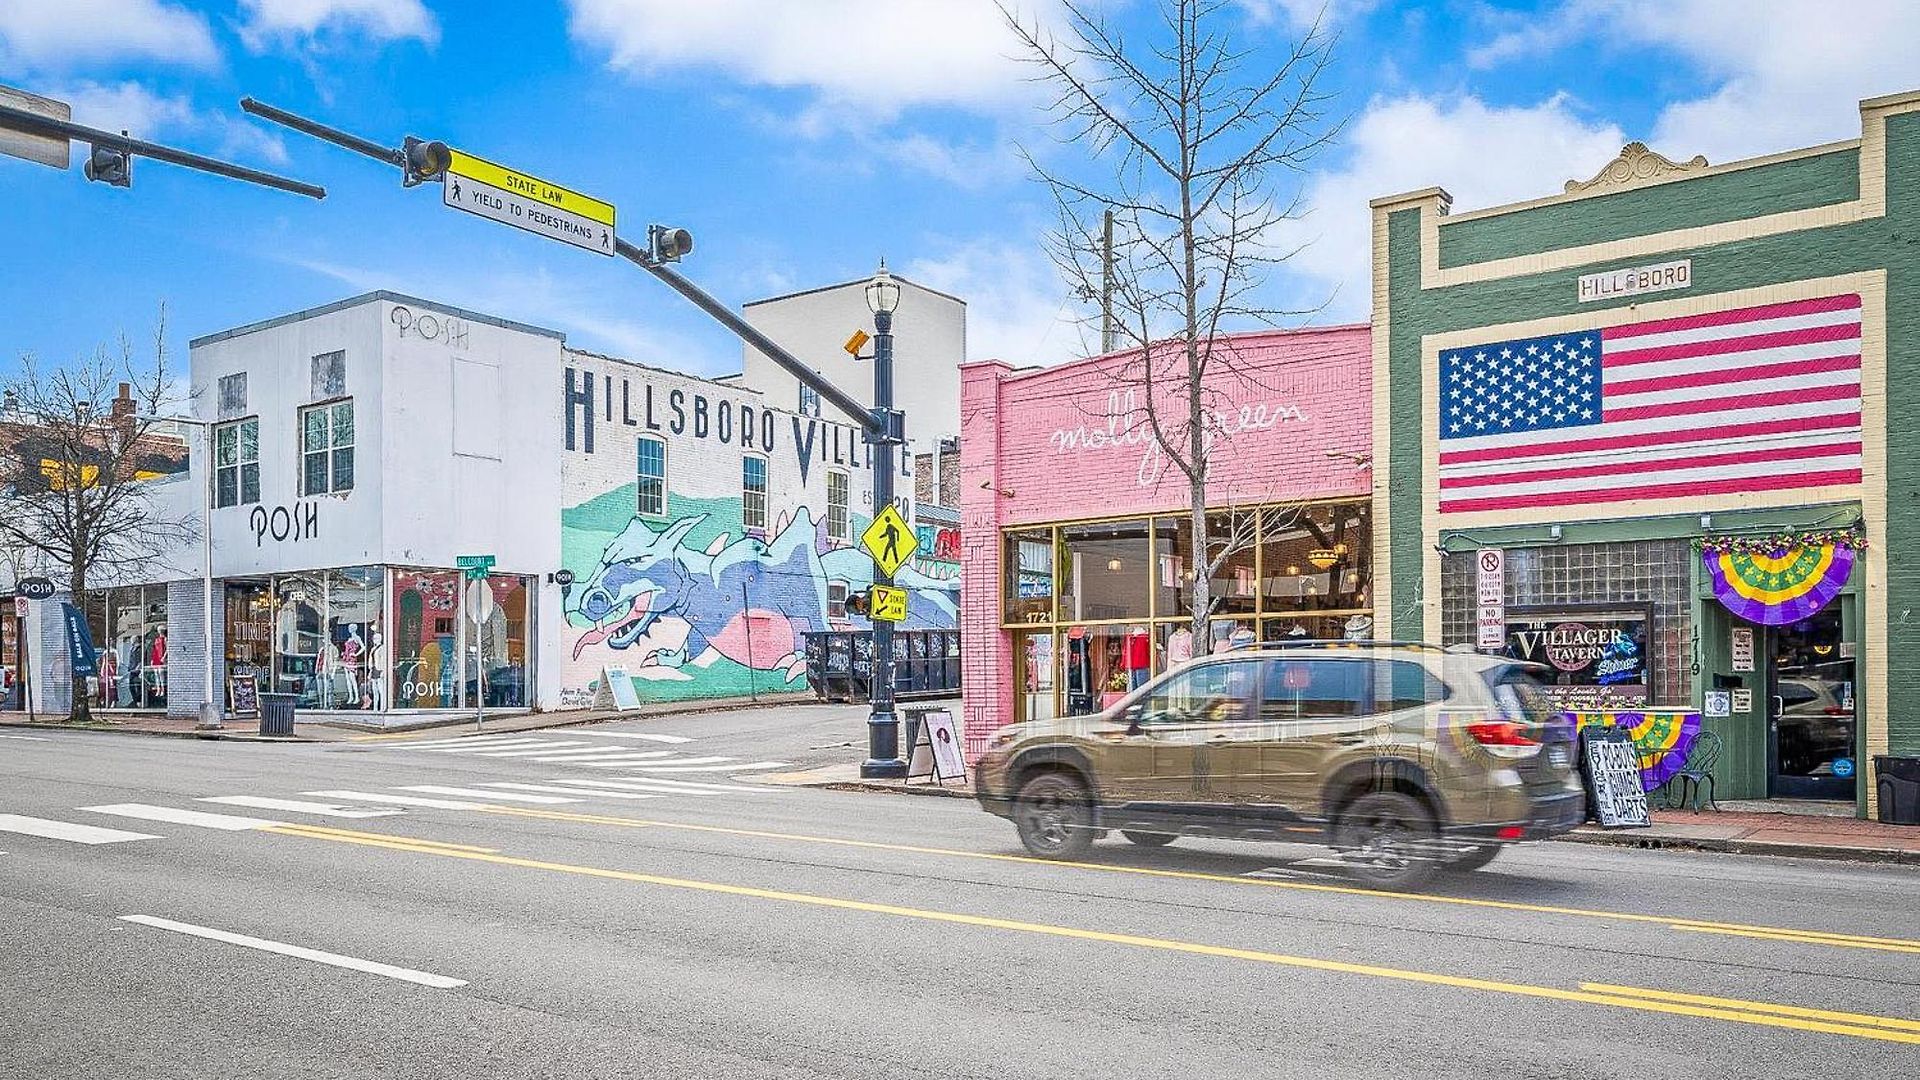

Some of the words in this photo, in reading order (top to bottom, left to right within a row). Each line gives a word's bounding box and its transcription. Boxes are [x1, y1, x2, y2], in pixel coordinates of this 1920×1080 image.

[506, 175, 537, 196] STATE
[542, 187, 563, 204] LAW
[471, 190, 503, 210] YIELD
[509, 203, 523, 217] TO
[528, 209, 593, 239] PEDESTRIANS
[1582, 266, 1687, 296] HILLSBORO
[565, 367, 774, 454] HILLSBORO
[791, 416, 912, 489] VILLE
[1050, 388, 1167, 486] molly
[250, 501, 319, 548] POSH
[21, 583, 52, 594] POSH
[889, 594, 905, 604] STATE
[890, 605, 902, 615] LAW
[1026, 611, 1053, 624] 1721
[1485, 608, 1496, 618] NO
[234, 621, 270, 640] TIME
[1528, 621, 1548, 630] THE
[1512, 628, 1623, 660] VILLAGER
[1553, 647, 1607, 660] TAVERN
[1691, 624, 1701, 676] 1719
[402, 681, 444, 699] POSH
[1613, 797, 1648, 819] DARTS
